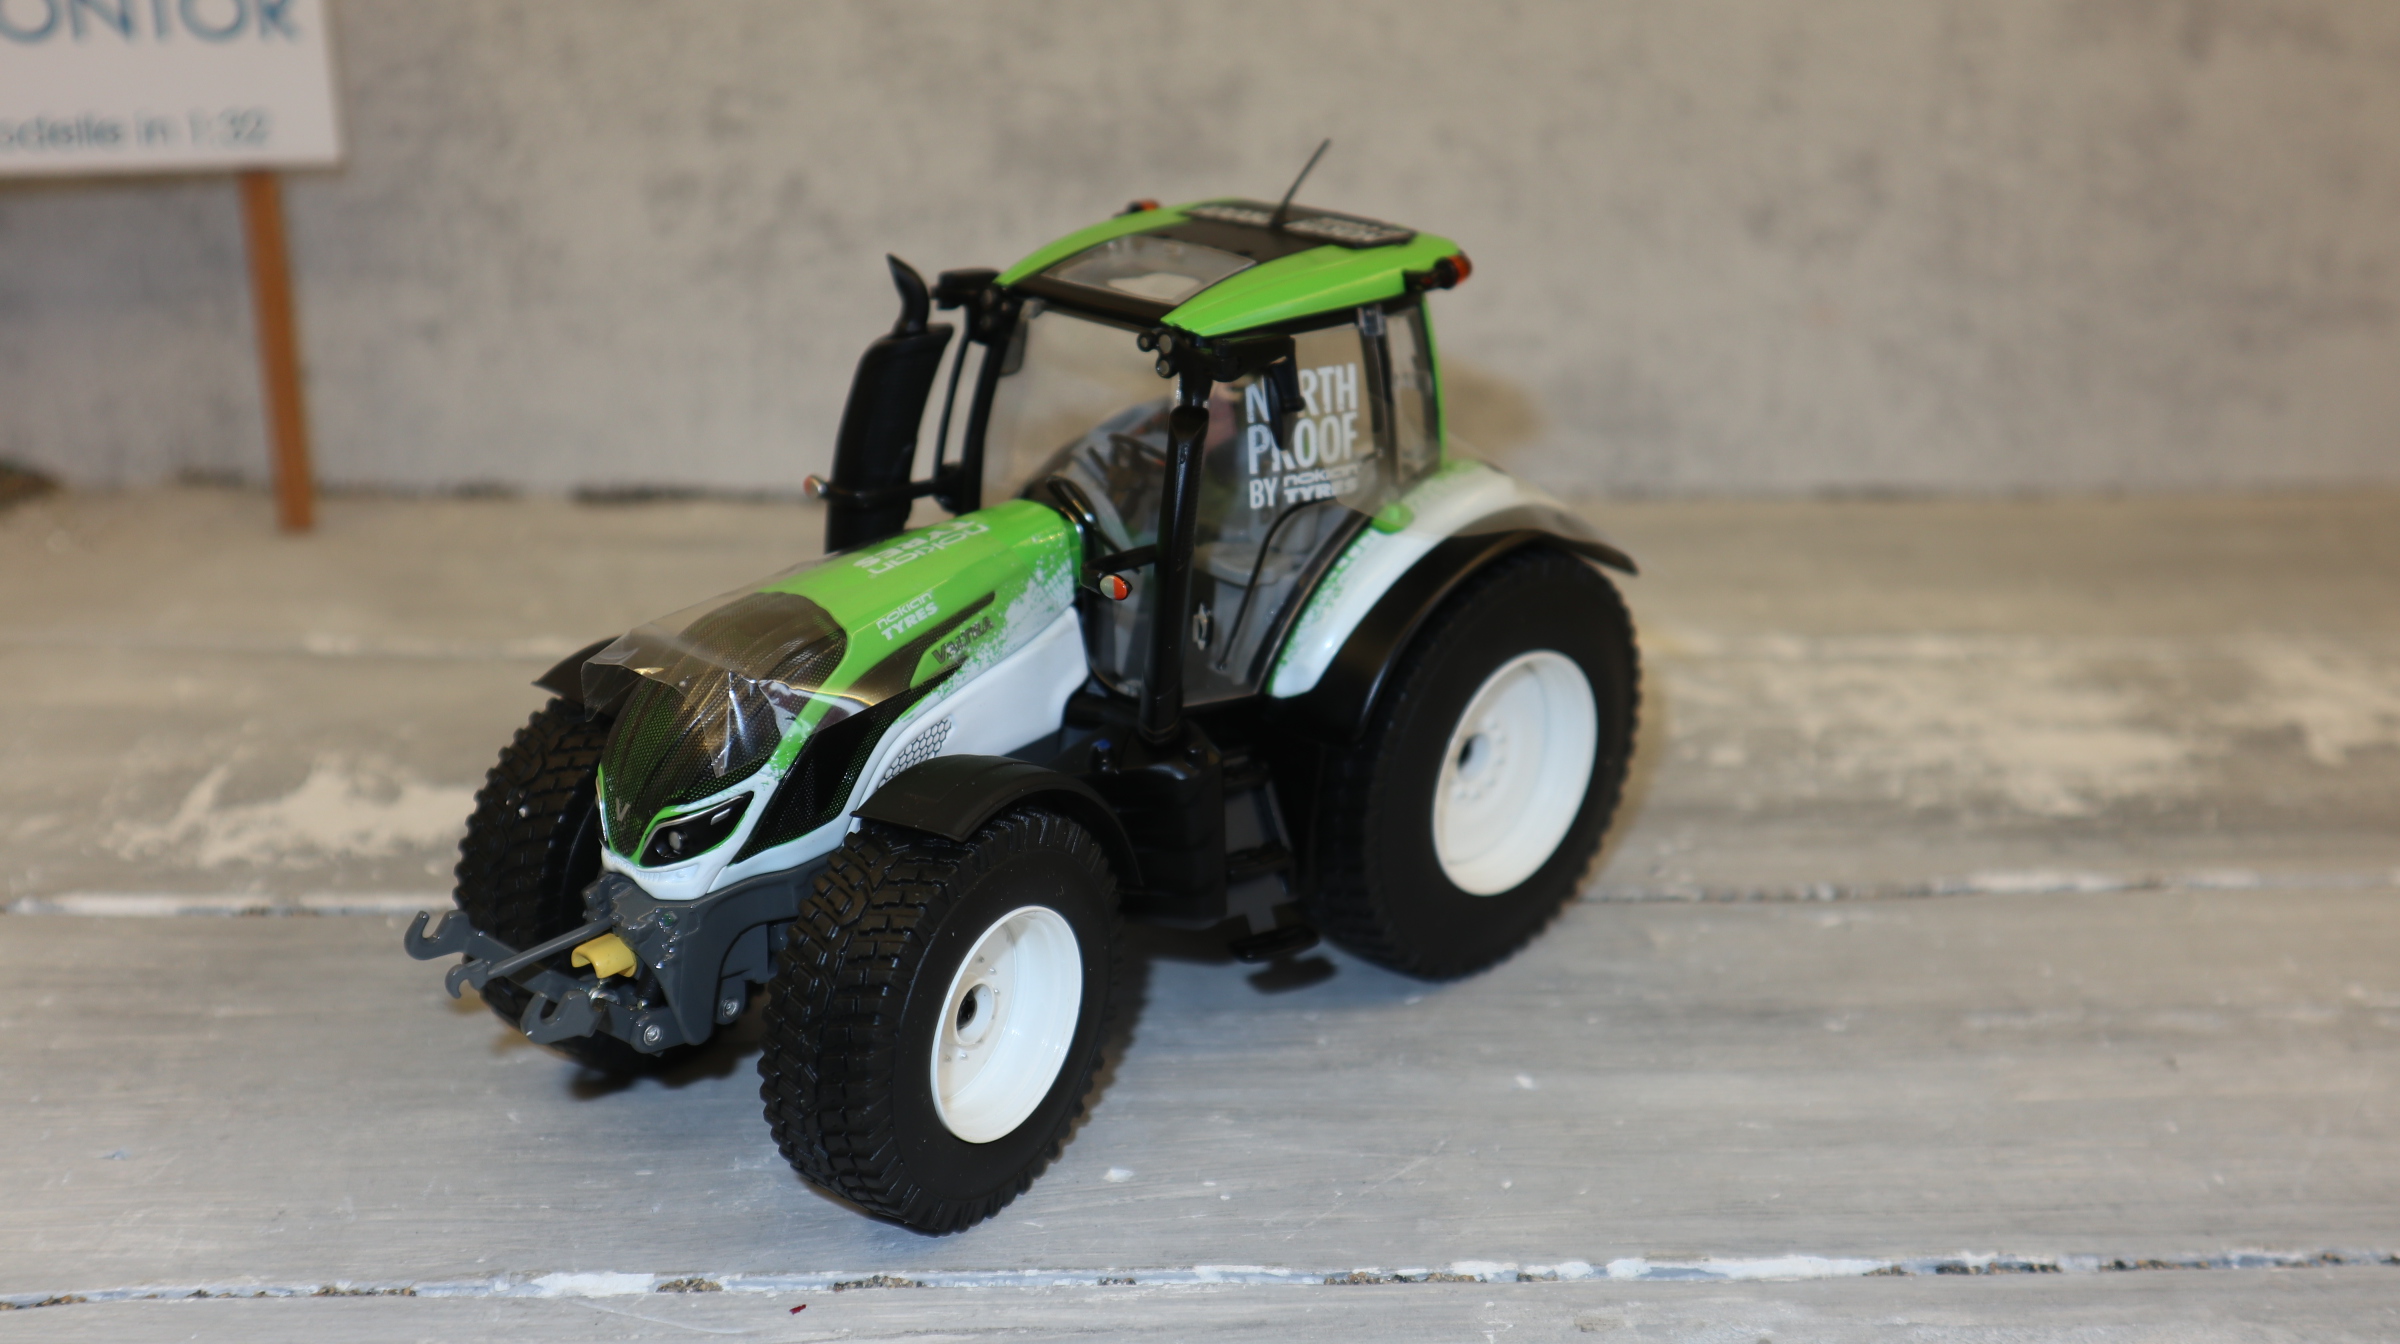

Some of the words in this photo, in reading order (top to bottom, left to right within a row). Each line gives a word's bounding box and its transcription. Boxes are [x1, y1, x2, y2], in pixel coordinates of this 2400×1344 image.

[1245, 363, 1357, 424] NRTH
[1250, 476, 1277, 509] BY
[881, 602, 938, 641] TYRES
